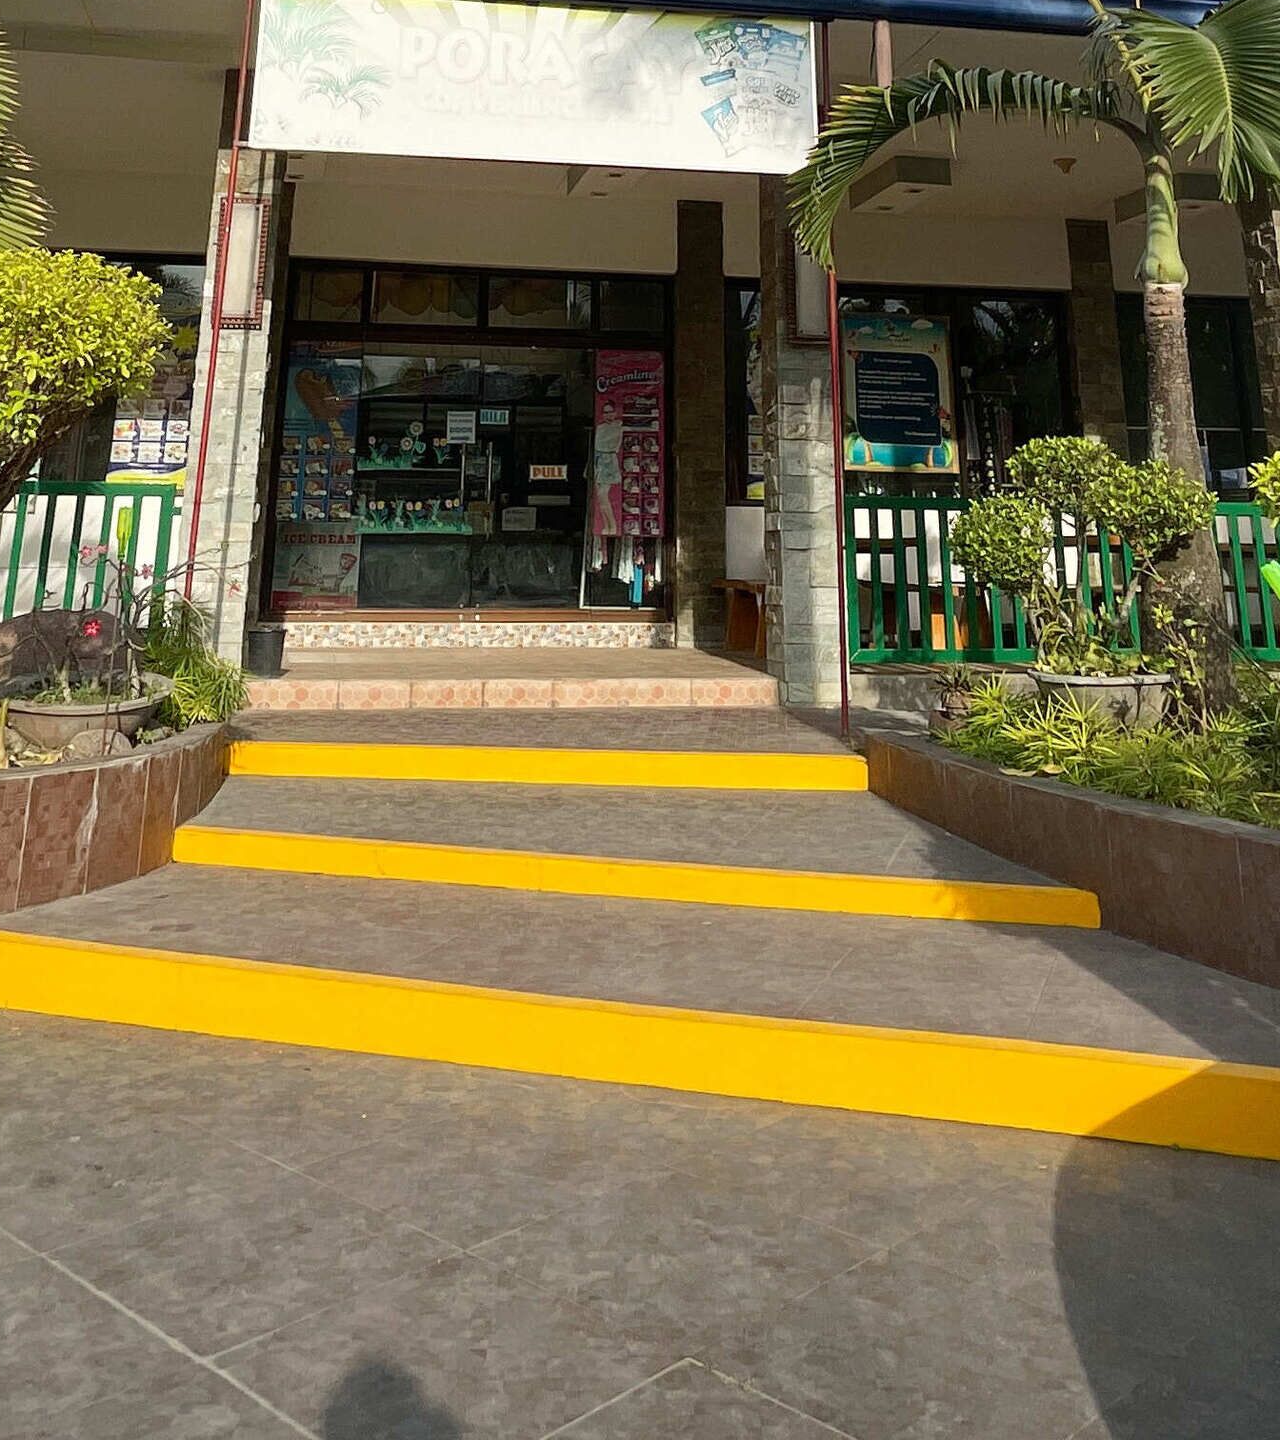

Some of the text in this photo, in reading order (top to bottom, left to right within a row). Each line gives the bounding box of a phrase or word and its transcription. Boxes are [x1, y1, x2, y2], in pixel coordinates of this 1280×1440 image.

[532, 466, 564, 478] PULL
[283, 534, 356, 545] ICE CREAM
